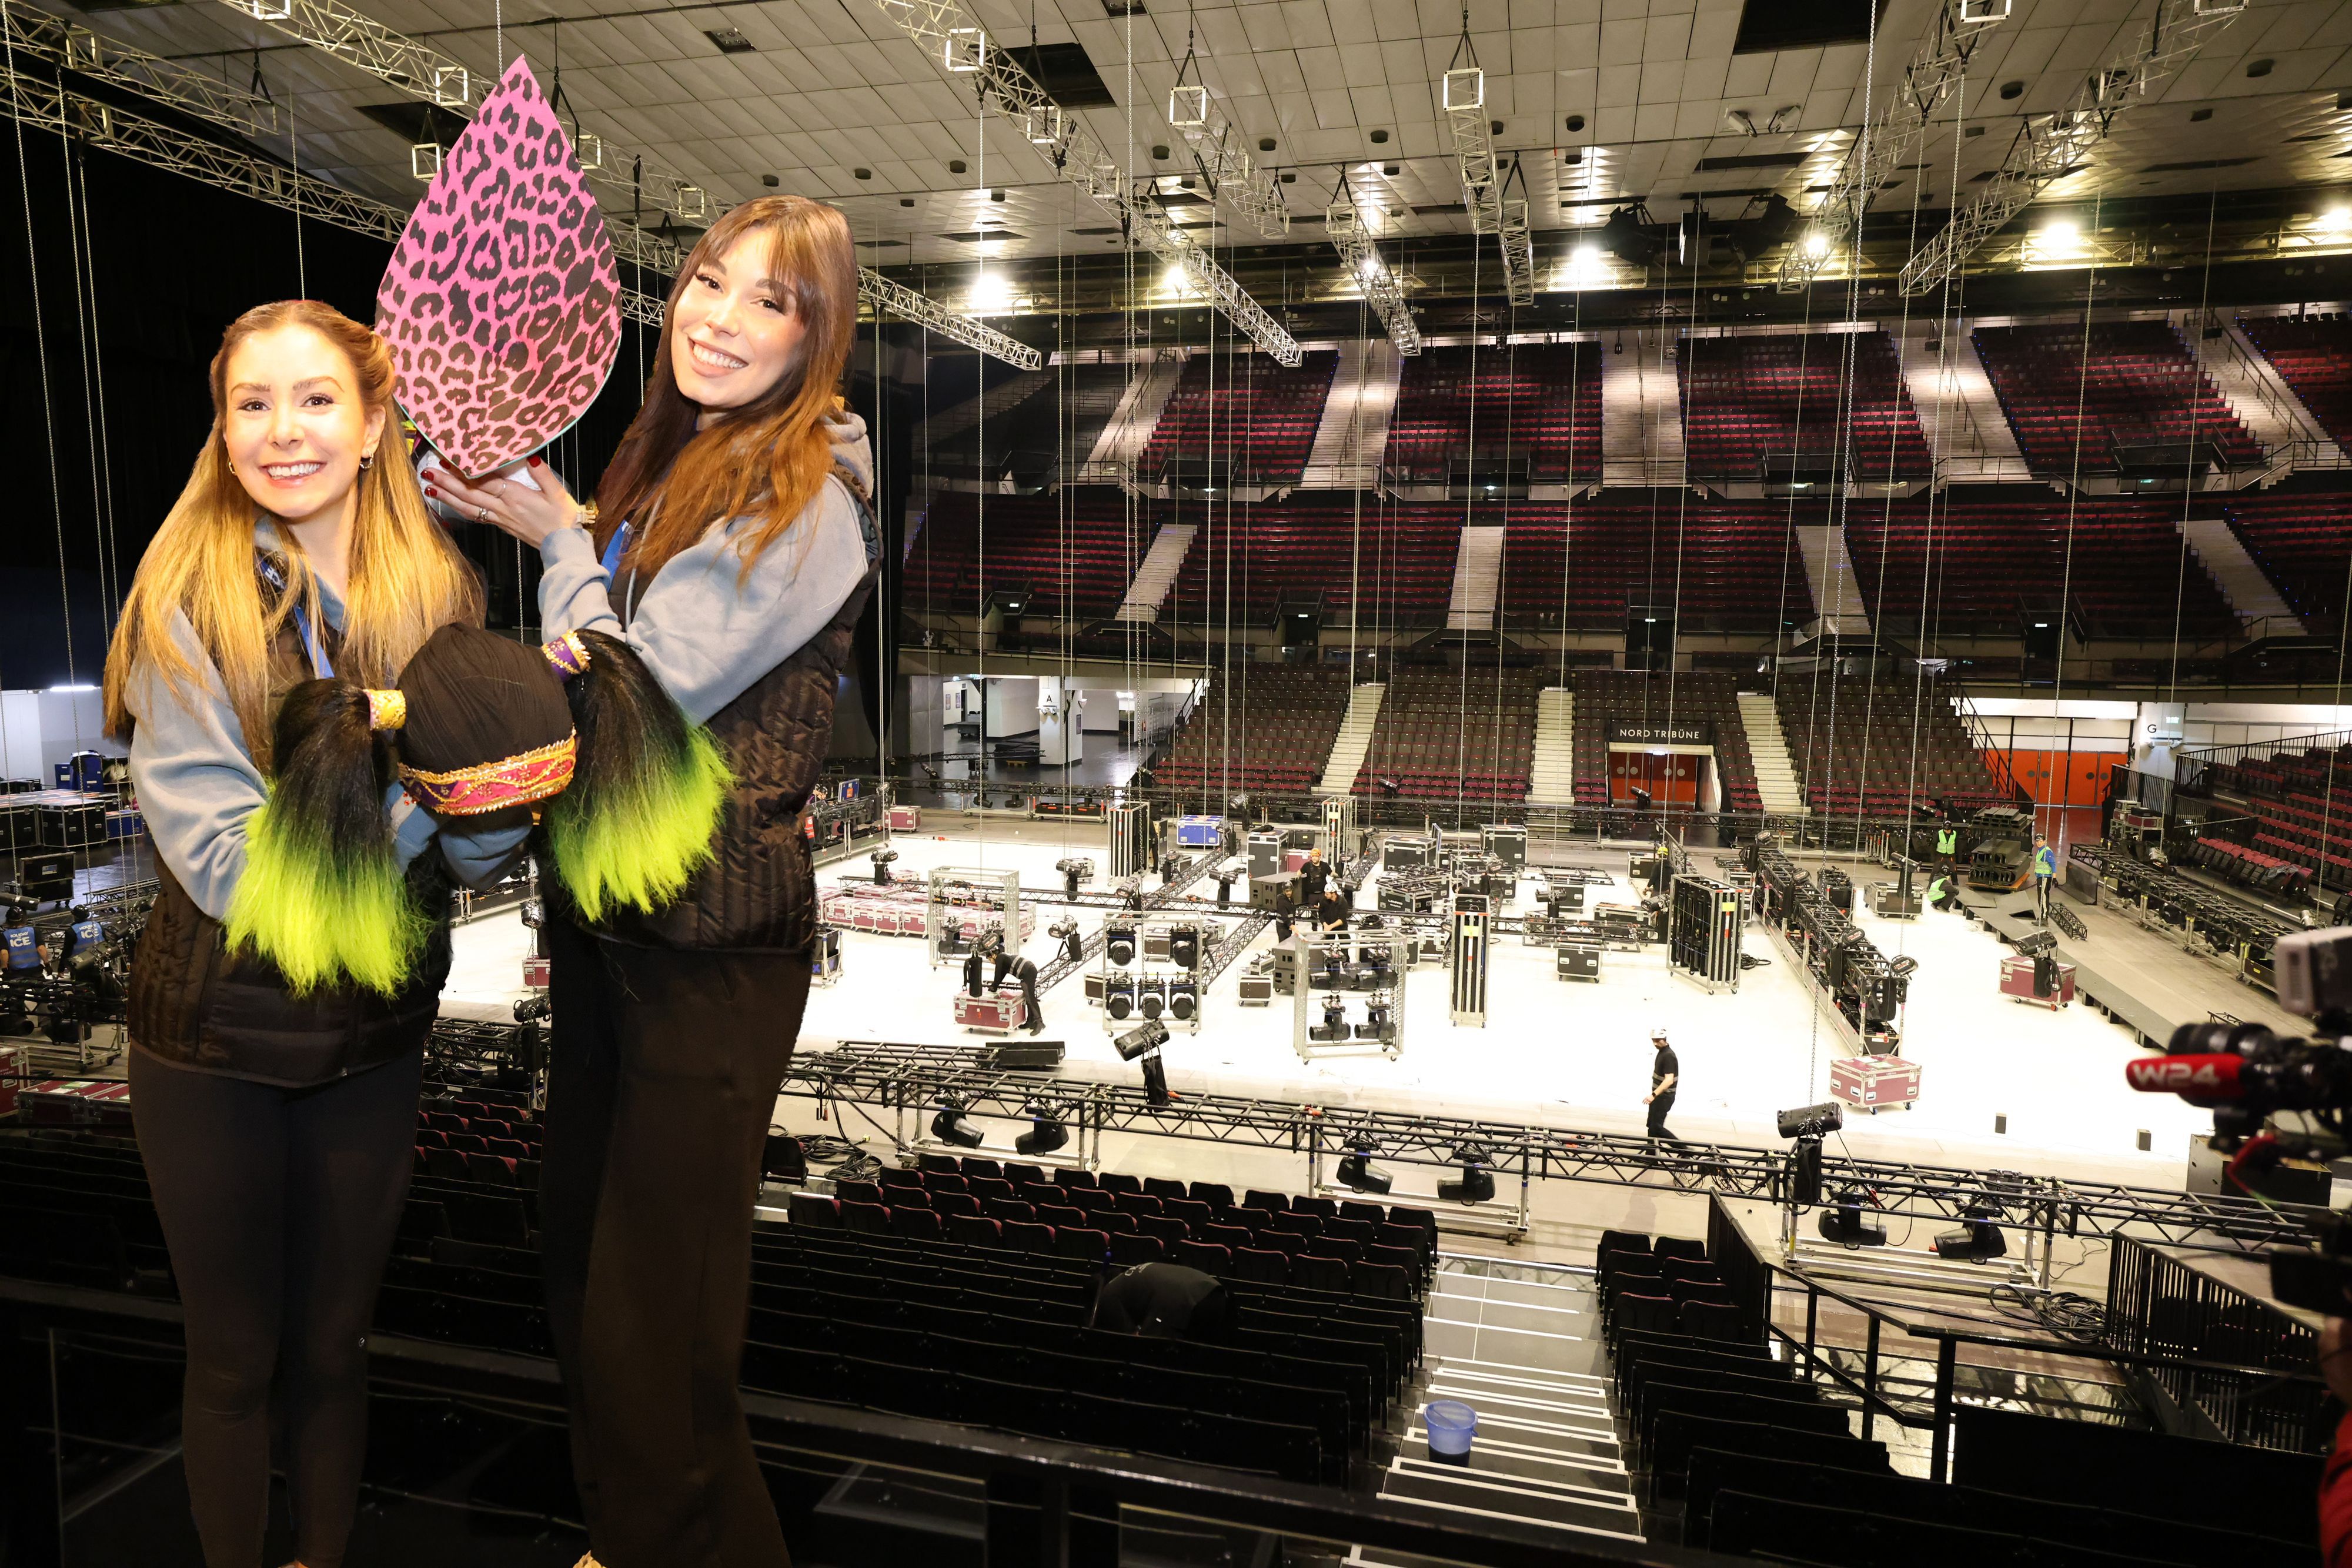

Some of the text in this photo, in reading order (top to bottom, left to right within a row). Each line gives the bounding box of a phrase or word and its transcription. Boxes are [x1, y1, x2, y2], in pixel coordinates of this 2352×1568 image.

[1047, 694, 1052, 703] A
[2147, 724, 2157, 733] G
[1620, 729, 1699, 739] NORD TRIBÜNE
[9, 937, 32, 947] ICE
[2133, 1062, 2221, 1086] W24
